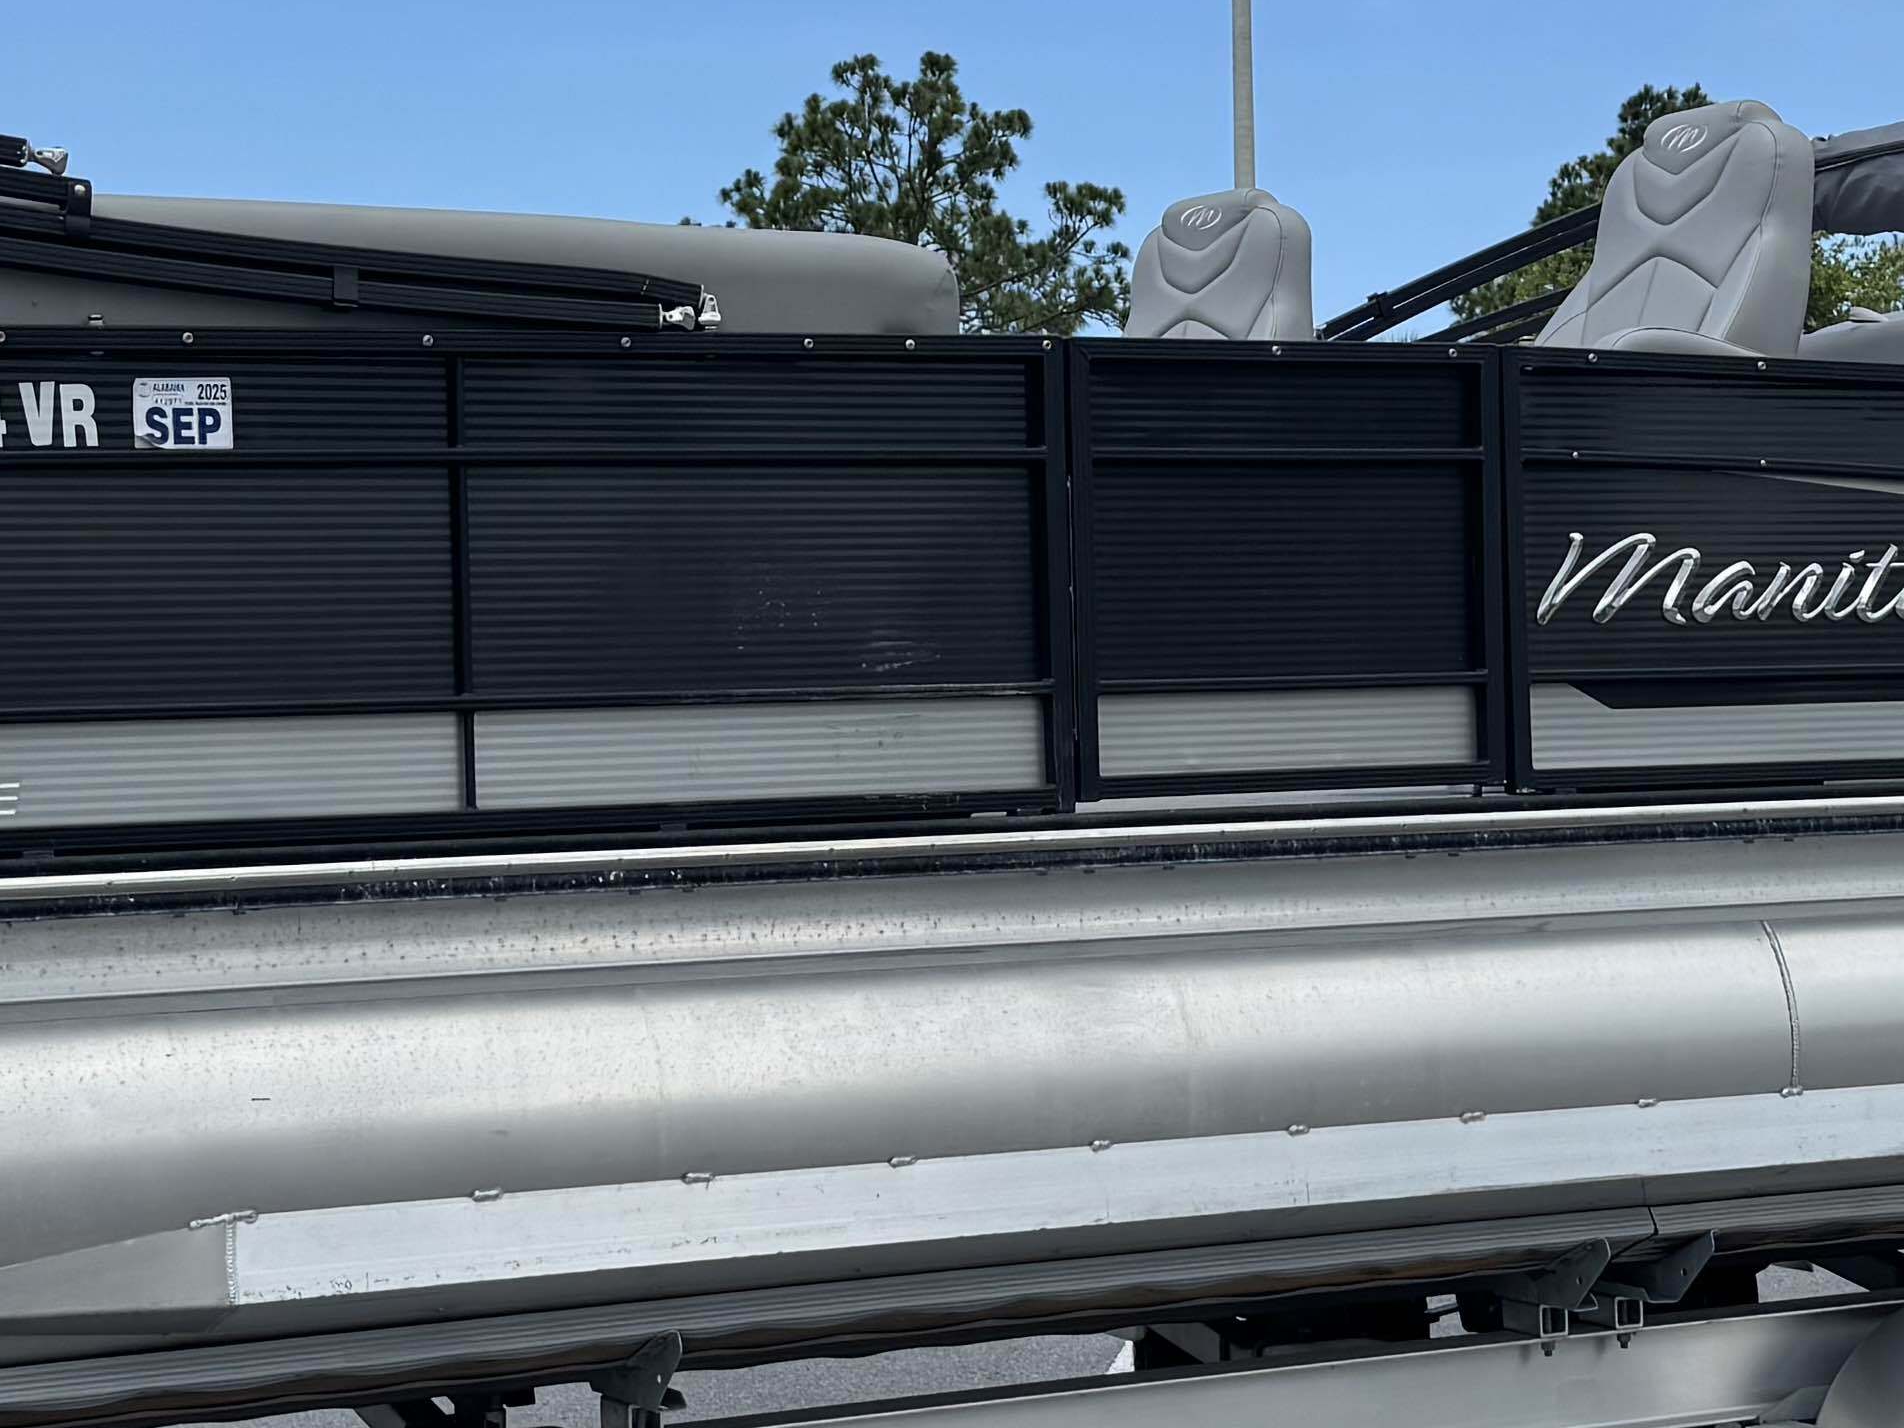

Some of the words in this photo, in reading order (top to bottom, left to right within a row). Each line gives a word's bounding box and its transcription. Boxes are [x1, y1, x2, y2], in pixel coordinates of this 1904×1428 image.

[197, 383, 228, 401] 2025
[18, 381, 99, 448] VR
[145, 406, 222, 446] SEP
